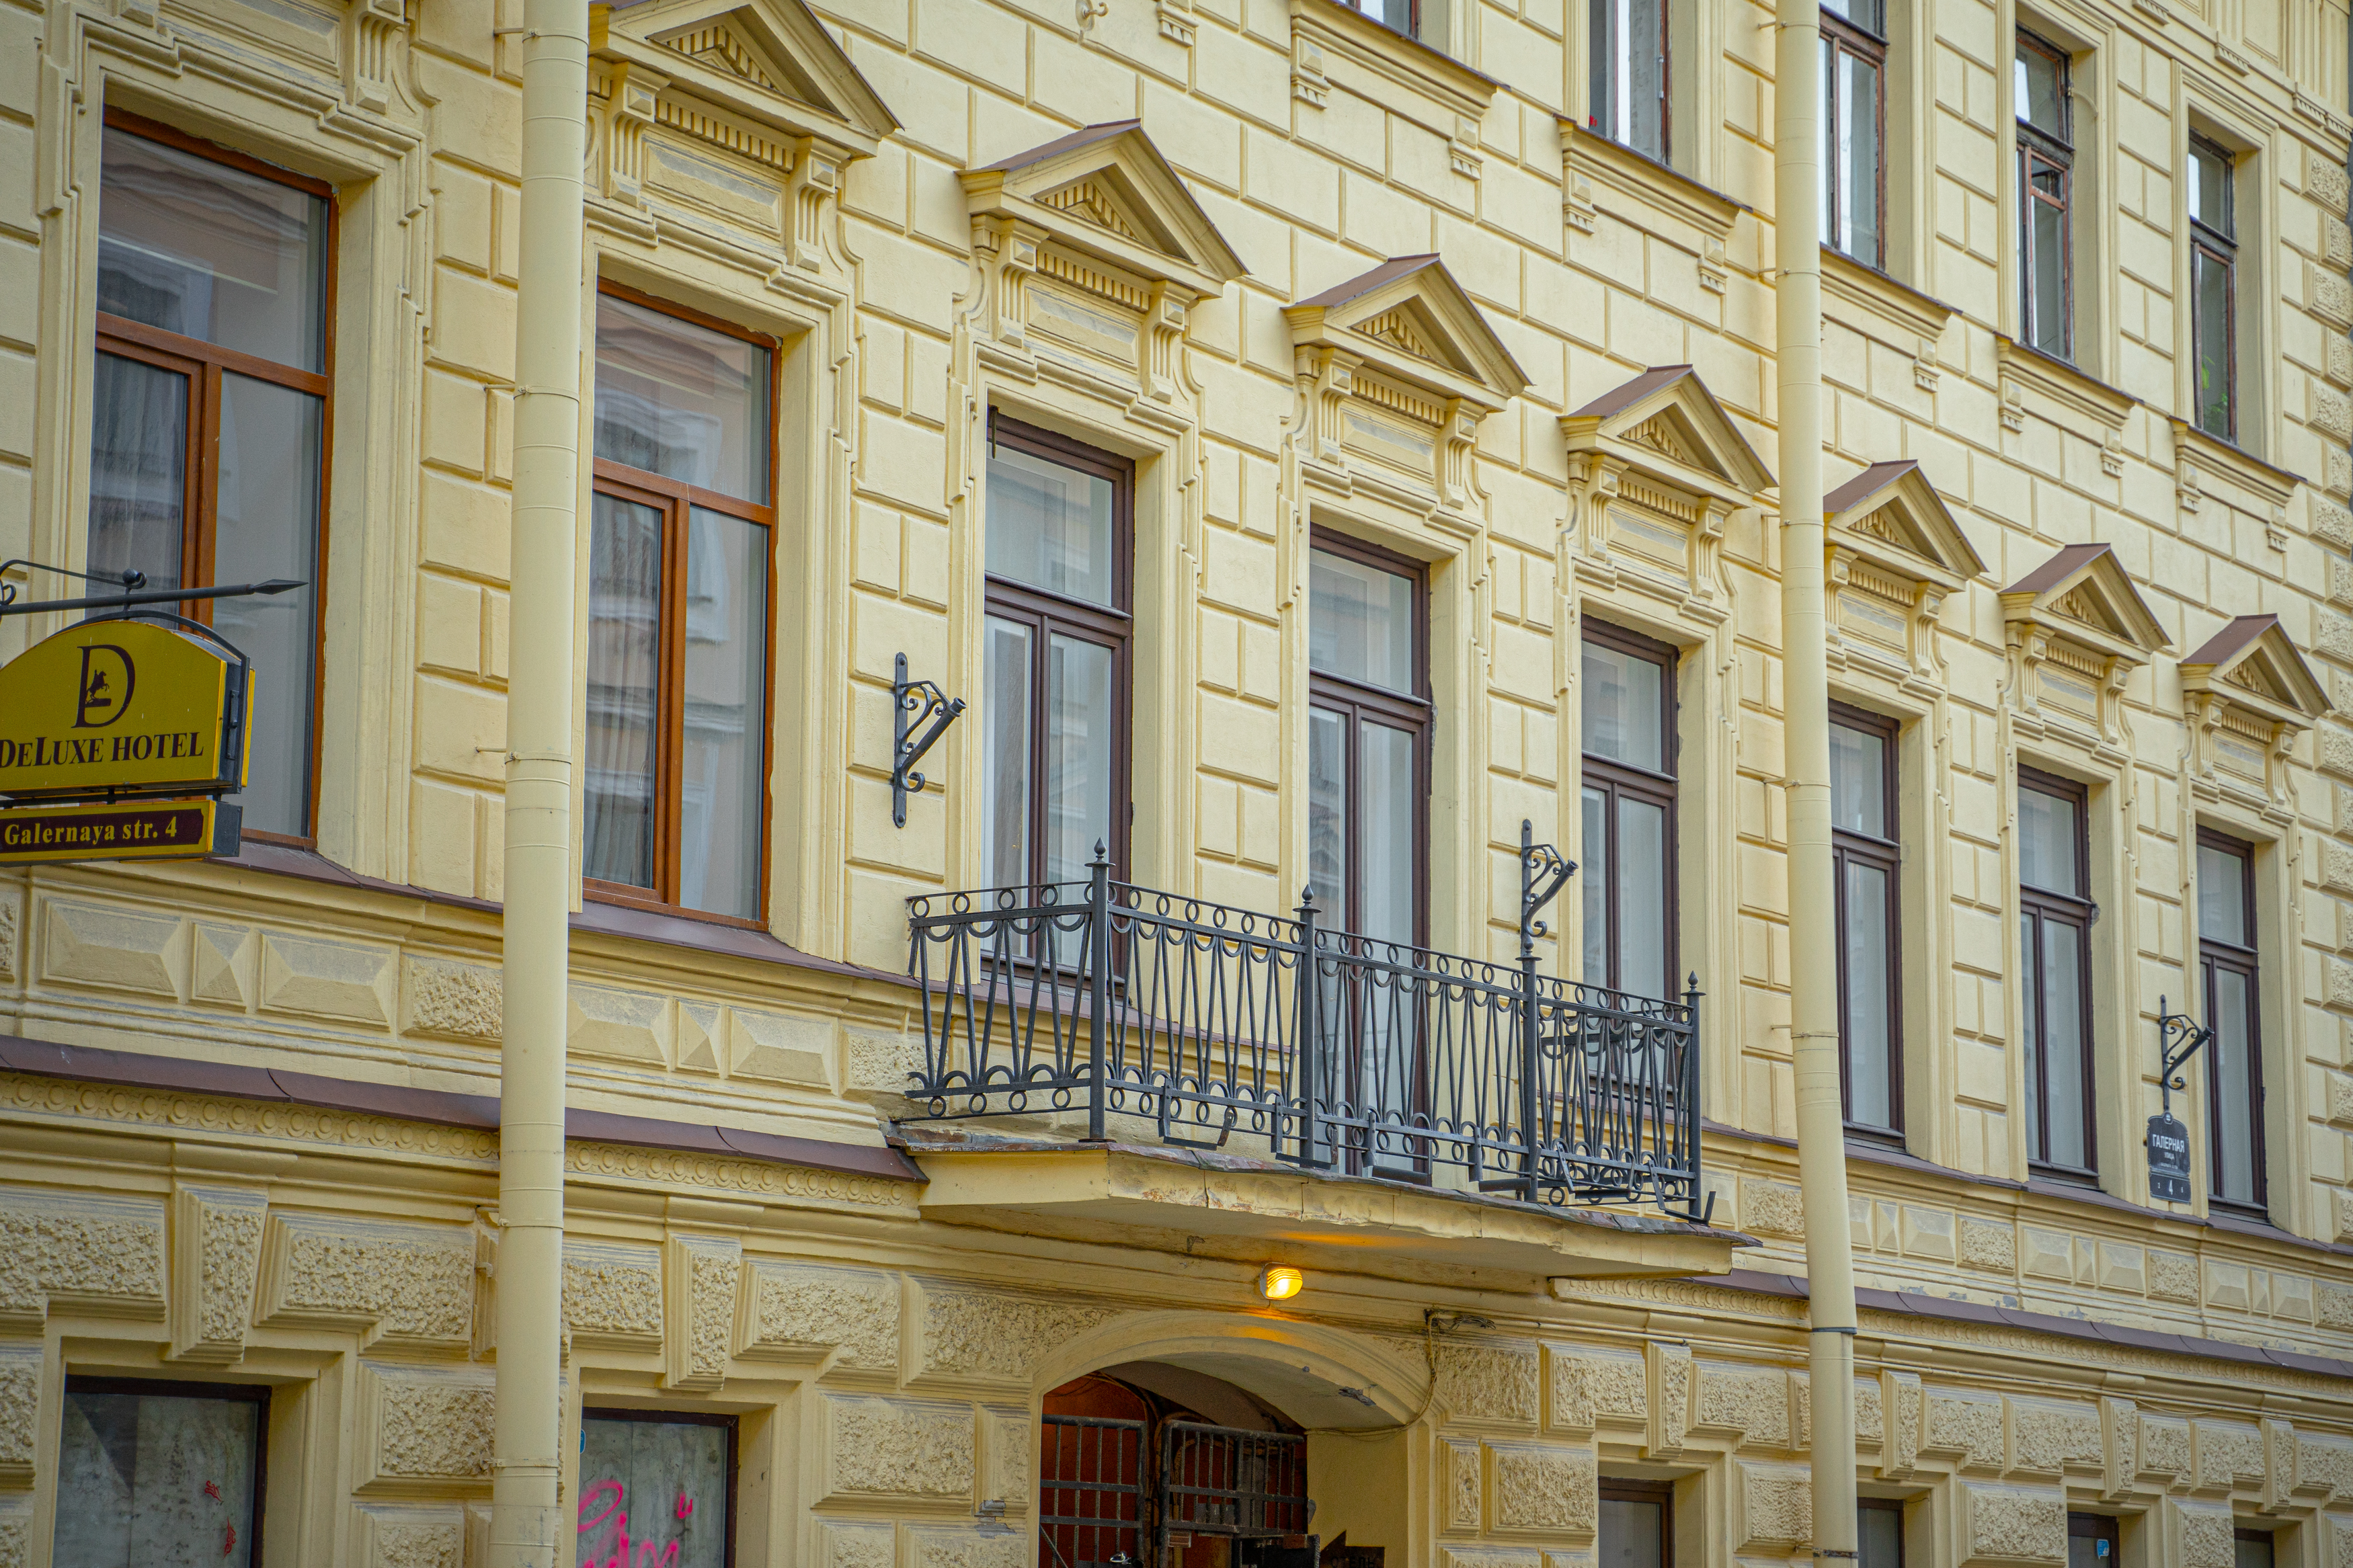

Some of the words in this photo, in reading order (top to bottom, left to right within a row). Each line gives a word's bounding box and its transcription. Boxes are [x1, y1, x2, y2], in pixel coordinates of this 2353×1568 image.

[71, 644, 135, 729] D
[110, 732, 204, 761] HOTEL
[5, 823, 115, 845] Galernaya
[122, 820, 158, 840] str.
[165, 816, 177, 837] 4
[2152, 1134, 2185, 1153] ГАЛЕРНАЯ
[2169, 1180, 2173, 1195] 4
